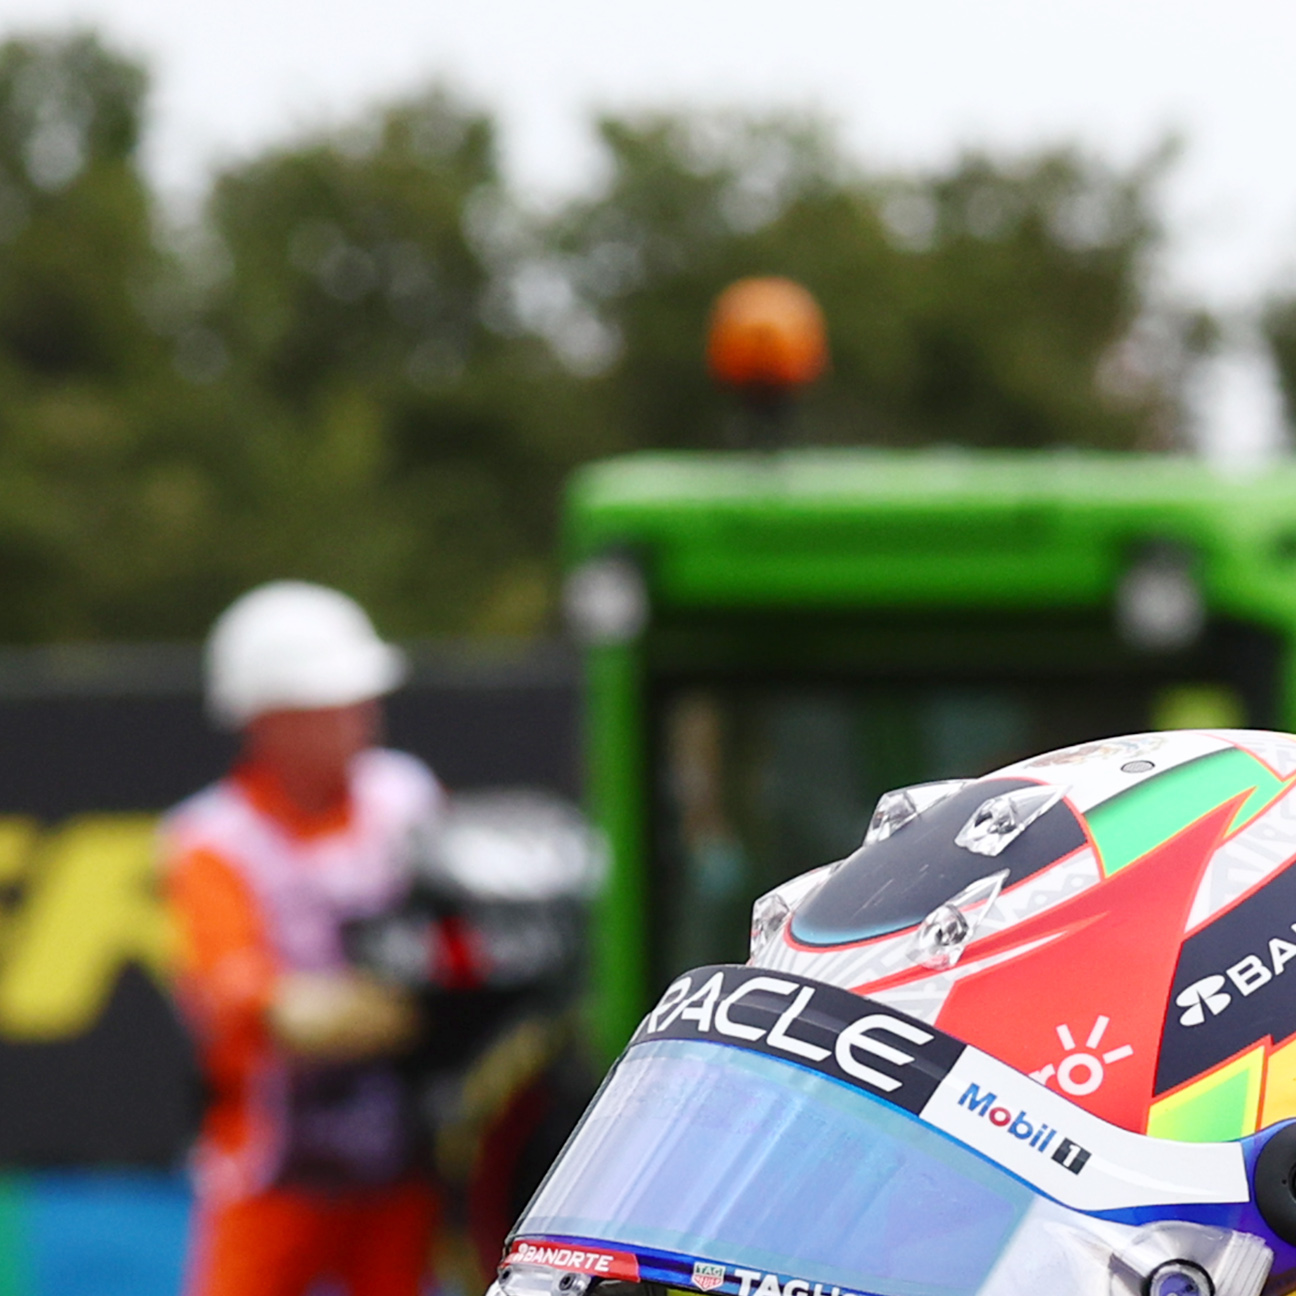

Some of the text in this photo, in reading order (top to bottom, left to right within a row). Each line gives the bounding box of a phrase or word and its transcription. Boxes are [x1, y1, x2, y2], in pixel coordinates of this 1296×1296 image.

[630, 971, 934, 1093] RACLE
[957, 1082, 1058, 1153] Mobil
[525, 1245, 614, 1272] BANORTE
